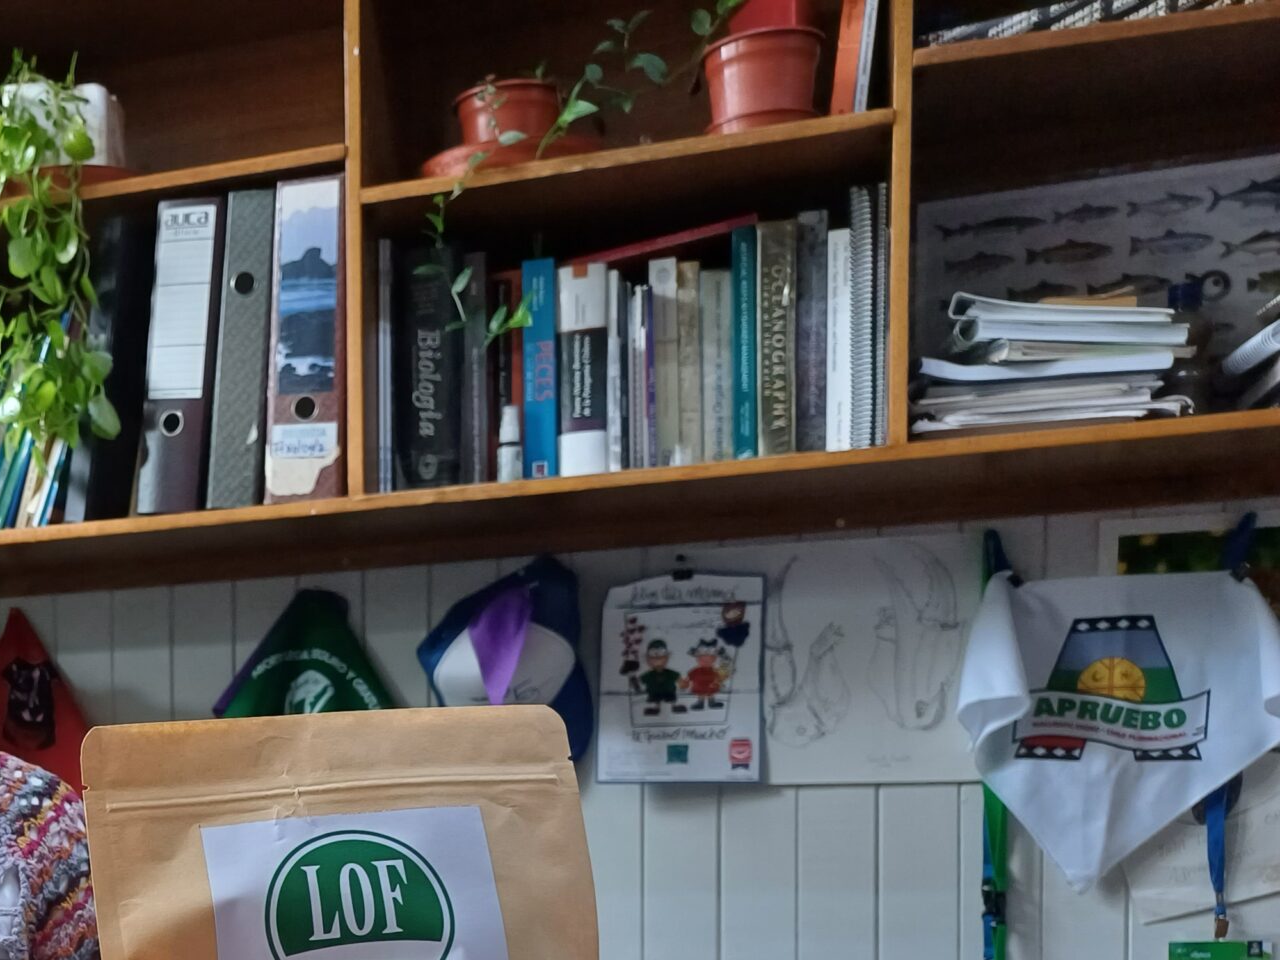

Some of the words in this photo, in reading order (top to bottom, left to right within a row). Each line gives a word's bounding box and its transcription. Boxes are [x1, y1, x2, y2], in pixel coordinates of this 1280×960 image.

[534, 340, 554, 402] PECES
[770, 263, 788, 431] OCEANOGRAPHY
[1033, 696, 1187, 731] APRUEBO
[300, 858, 408, 941] LOF
